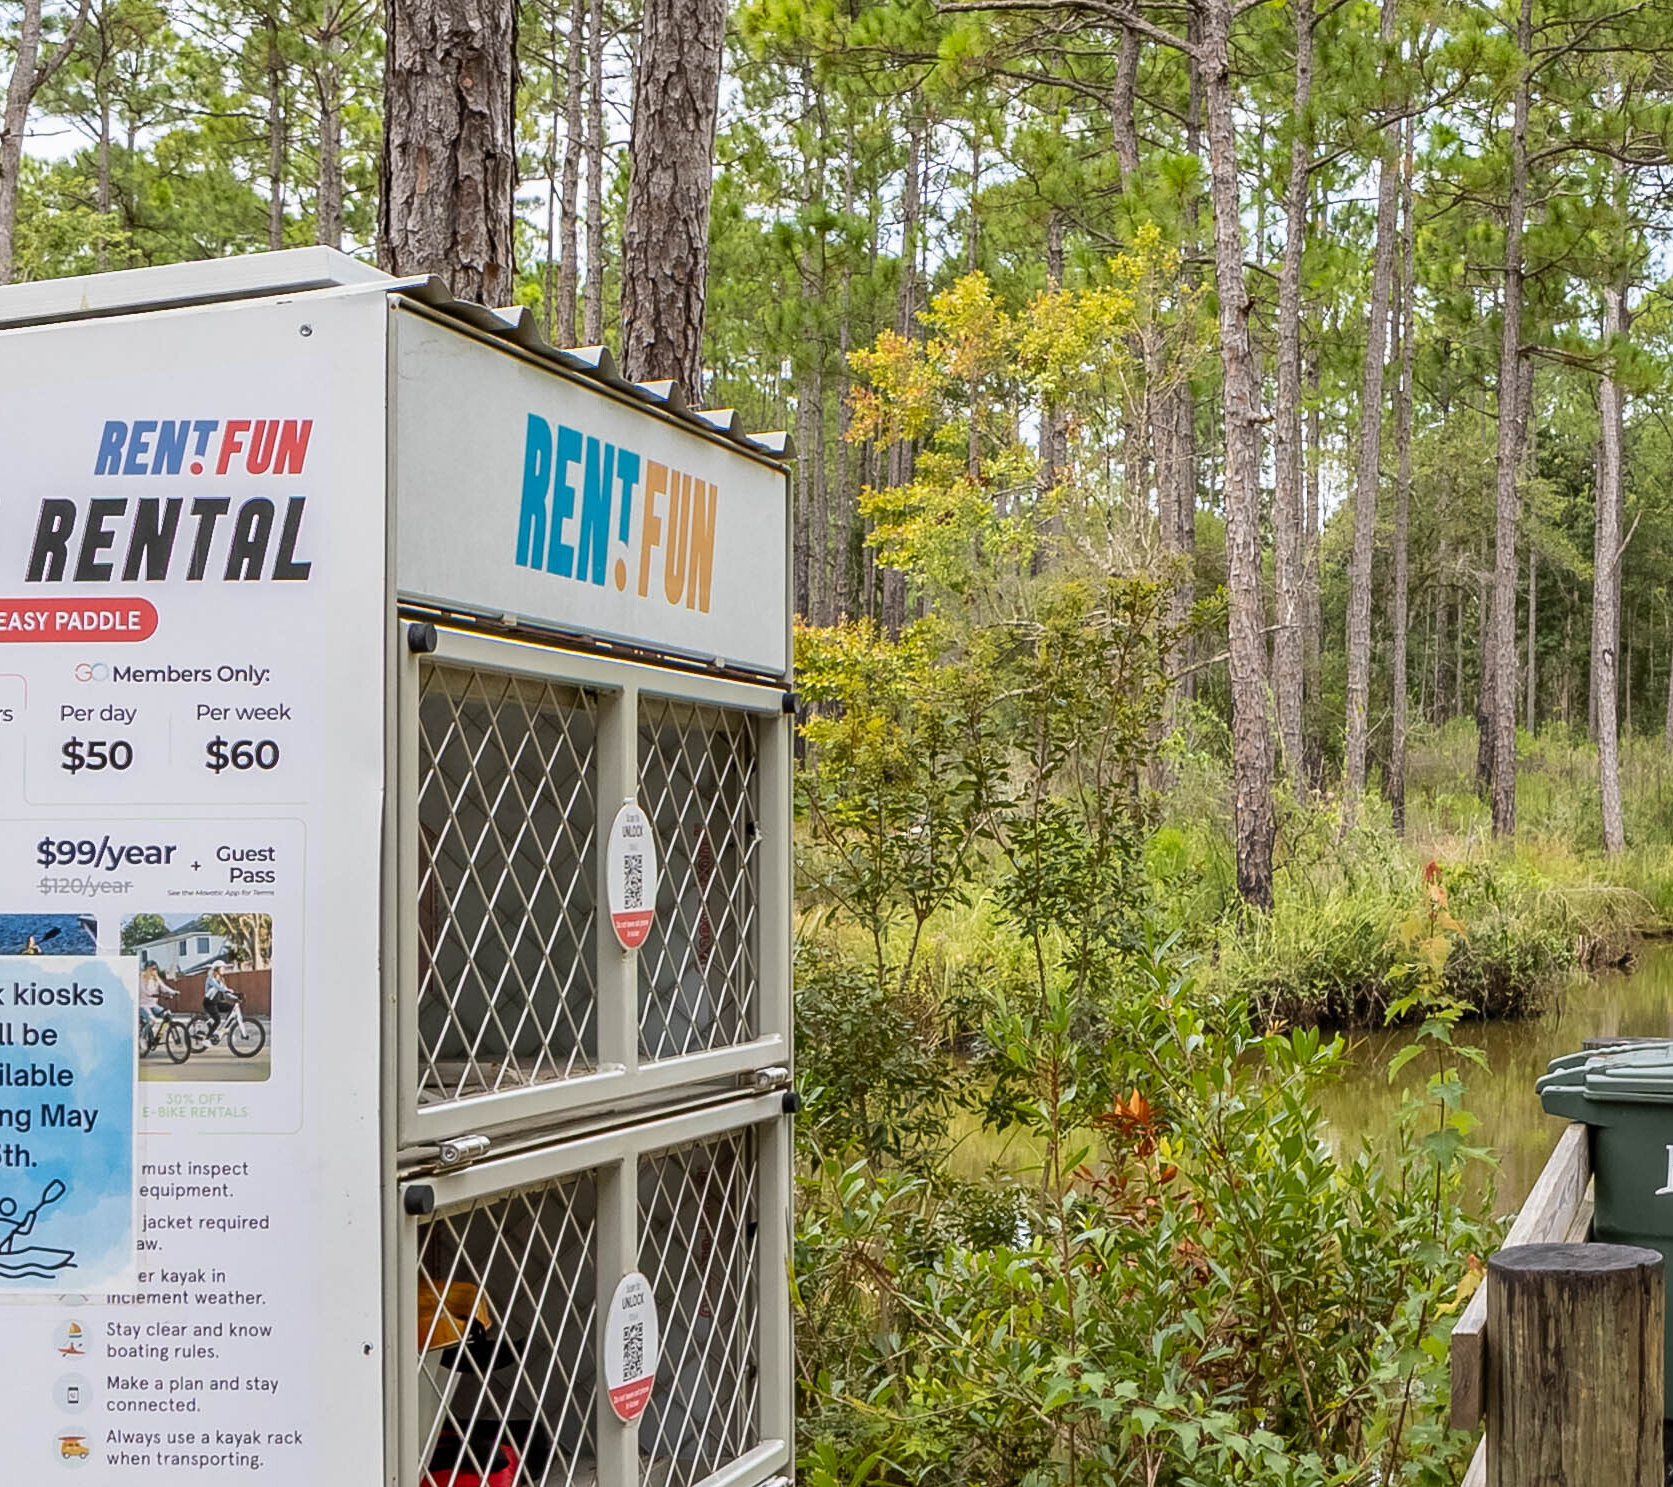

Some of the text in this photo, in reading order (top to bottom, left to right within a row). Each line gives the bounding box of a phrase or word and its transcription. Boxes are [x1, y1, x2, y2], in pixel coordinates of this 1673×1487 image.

[25, 496, 313, 583] RENTAL
[56, 610, 141, 631] PADDLE
[113, 663, 212, 684] Members
[217, 663, 270, 687] Only:
[61, 703, 137, 726] Per day
[197, 702, 291, 721] Per week
[61, 737, 134, 774] $50
[205, 736, 280, 773] $60
[37, 835, 177, 871] $99/year
[217, 846, 275, 862] Guest
[230, 868, 275, 883] Pass
[39, 875, 132, 897] $120/year
[13, 982, 104, 1006] kiosks
[25, 1024, 57, 1046] be
[167, 1094, 224, 1104] 30% OFF
[40, 1105, 98, 1133] May
[142, 1107, 248, 1118] E-BIKE RENTALS
[142, 1162, 248, 1178] must inspect
[140, 1184, 233, 1198] equipment.
[143, 1215, 269, 1232] jacket required
[161, 1269, 225, 1286] kayak in
[195, 1291, 265, 1304] weather.
[622, 1293, 644, 1310] UNLOCK
[107, 1322, 272, 1339] Stay clear and know
[107, 1345, 218, 1361] boating rules.
[107, 1376, 278, 1394] Make a plan and stay
[107, 1398, 200, 1412] connected.
[107, 1430, 302, 1448] Always use a kayak rack
[107, 1452, 263, 1469] when transporting.
